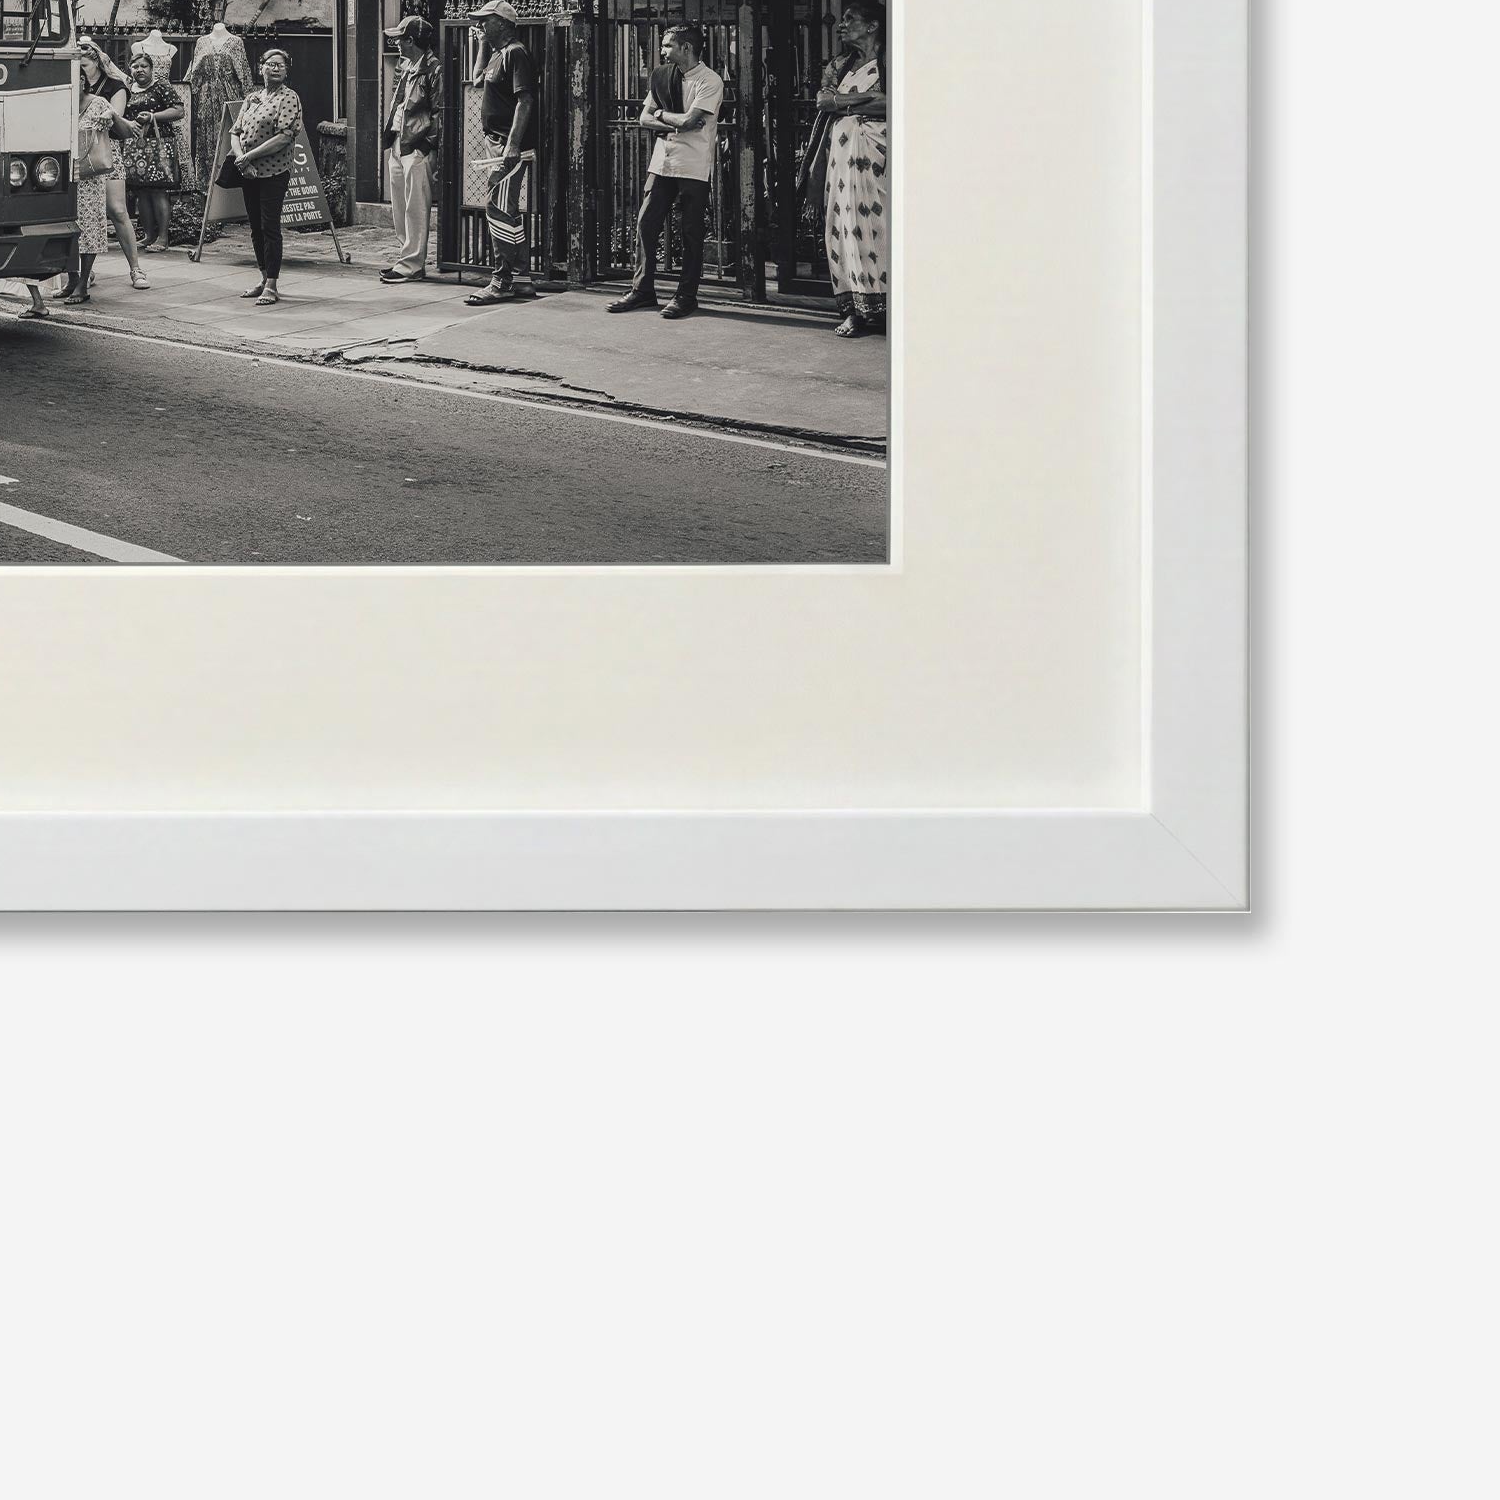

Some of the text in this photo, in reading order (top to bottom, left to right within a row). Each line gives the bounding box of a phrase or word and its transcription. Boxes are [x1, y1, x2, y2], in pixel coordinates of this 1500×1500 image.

[288, 187, 302, 197] THE
[301, 185, 319, 195] DOOR
[303, 201, 316, 211] PAS
[294, 212, 304, 222] LA
[303, 210, 323, 221] PORTE
